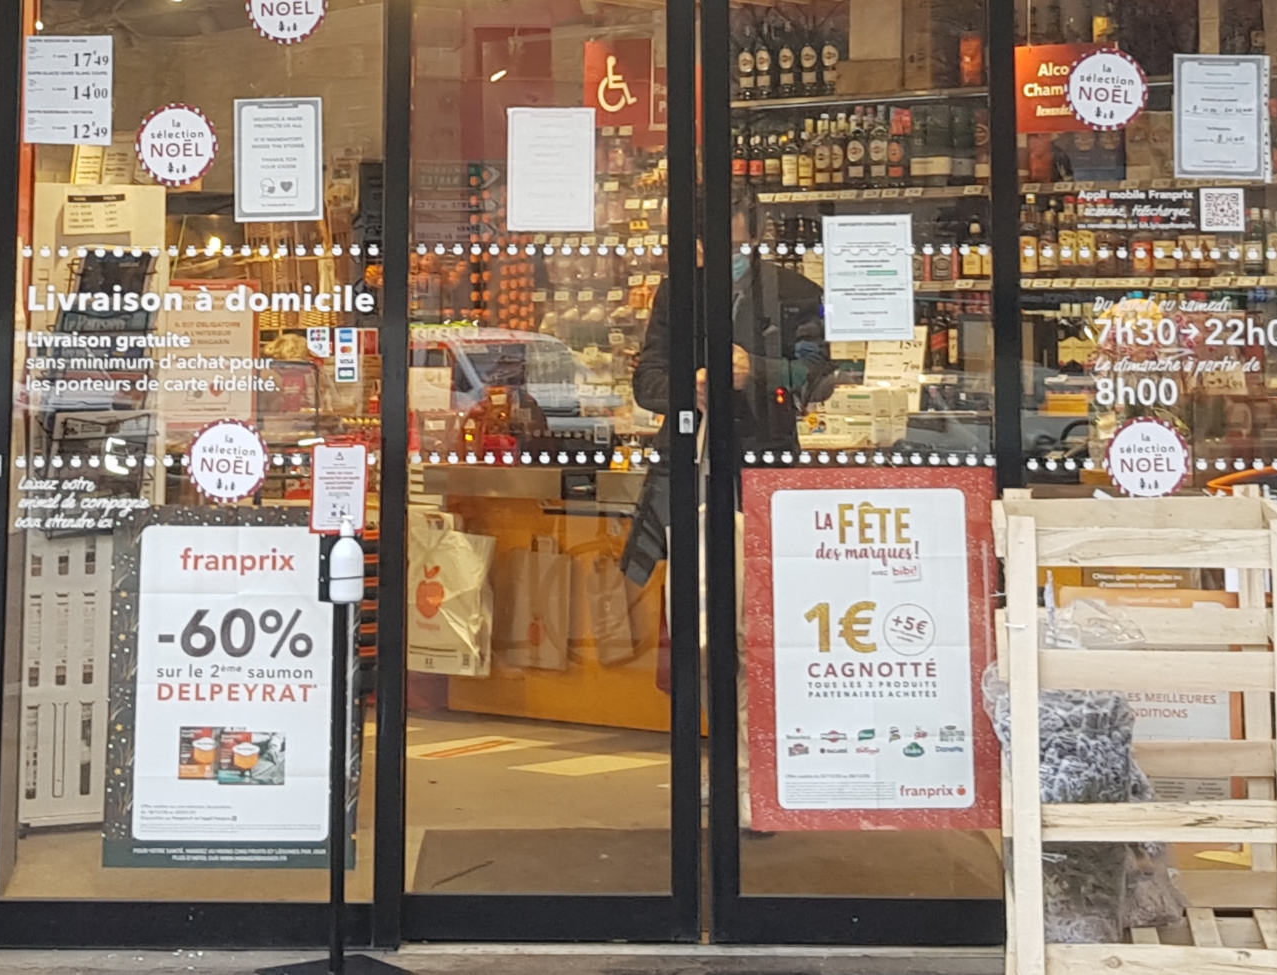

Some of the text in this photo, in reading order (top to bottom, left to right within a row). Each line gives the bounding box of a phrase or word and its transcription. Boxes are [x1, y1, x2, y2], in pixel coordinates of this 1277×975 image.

[1037, 62, 1070, 77] Alco
[1102, 64, 1112, 73] la
[1080, 73, 1135, 86] sélection
[1078, 85, 1133, 105] NOËL
[172, 119, 181, 128] la
[150, 128, 204, 139] sélection
[150, 139, 204, 158] NOËL
[1077, 190, 1194, 201] Appli mobile Franprix
[28, 284, 183, 312] Livraison
[195, 285, 213, 312] à
[225, 283, 375, 312] domicile
[1093, 296, 1114, 313] Du
[1179, 296, 1231, 313] samedi
[27, 331, 191, 352] Livraison gratuite
[1093, 318, 1176, 346] 7h30
[26, 353, 273, 374] sans minimum d'achat pour
[1094, 356, 1261, 377] Le dimanche à partir de
[25, 374, 281, 396] les porteurs de carte fidélité.
[1095, 378, 1178, 406] 8h00
[225, 435, 234, 444] la
[1141, 433, 1151, 442] la
[202, 445, 257, 457] sélection
[1119, 442, 1176, 454] sélection
[200, 456, 255, 476] NOËL
[1119, 454, 1176, 473] NOËL
[79, 495, 150, 518] compagnie
[815, 501, 912, 544] LA FÊTE
[816, 542, 841, 561] des
[180, 548, 295, 576] franprix
[158, 608, 313, 659] -60%
[804, 601, 878, 653] 1€
[892, 616, 928, 635] +5€
[156, 667, 182, 678] sur
[188, 664, 203, 678] le
[247, 667, 314, 679] saumon
[808, 659, 937, 678] CAGNOTTÉ
[1127, 692, 1217, 704] ES MEILLEURES
[1131, 708, 1188, 718] NDITIONS
[899, 785, 953, 798] franprix
